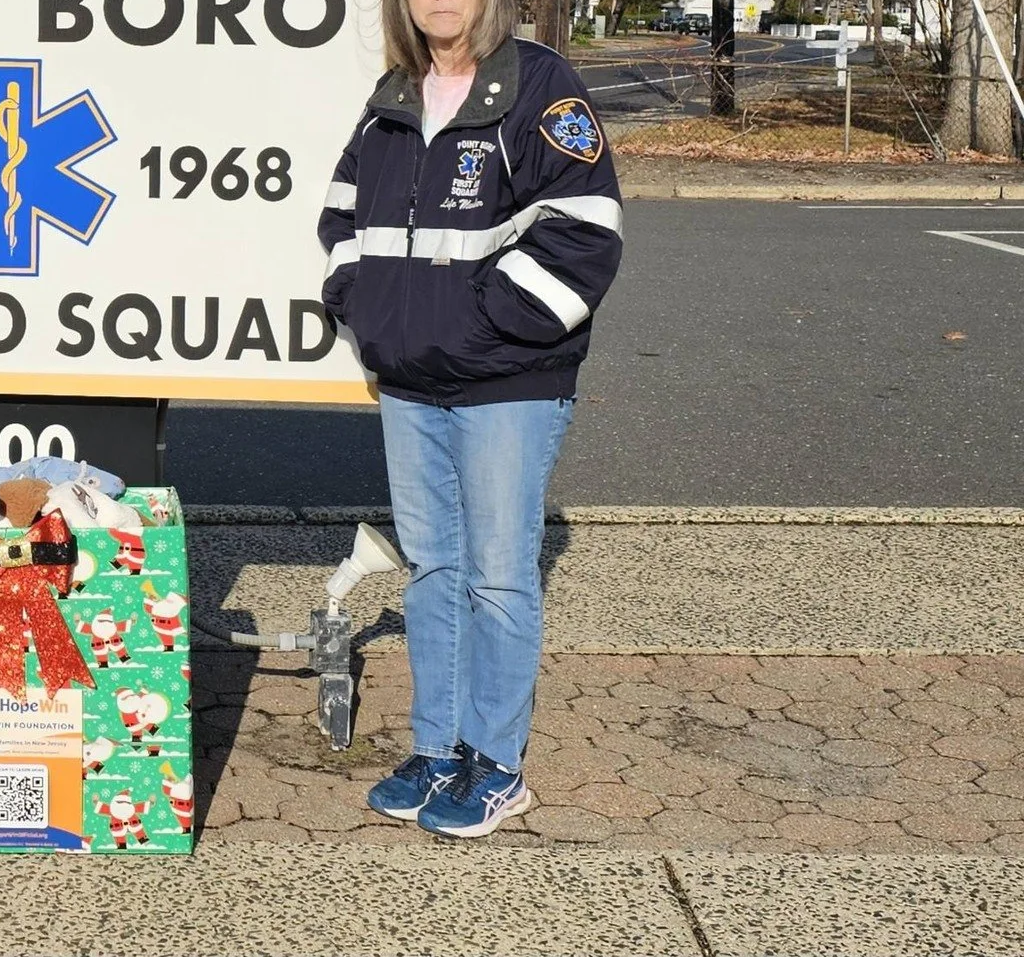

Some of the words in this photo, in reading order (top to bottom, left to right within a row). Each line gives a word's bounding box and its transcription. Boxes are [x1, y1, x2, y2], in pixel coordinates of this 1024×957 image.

[140, 146, 293, 202] 1968
[56, 293, 337, 362] SQUAD
[14, 722, 75, 730] FOUNDATION
